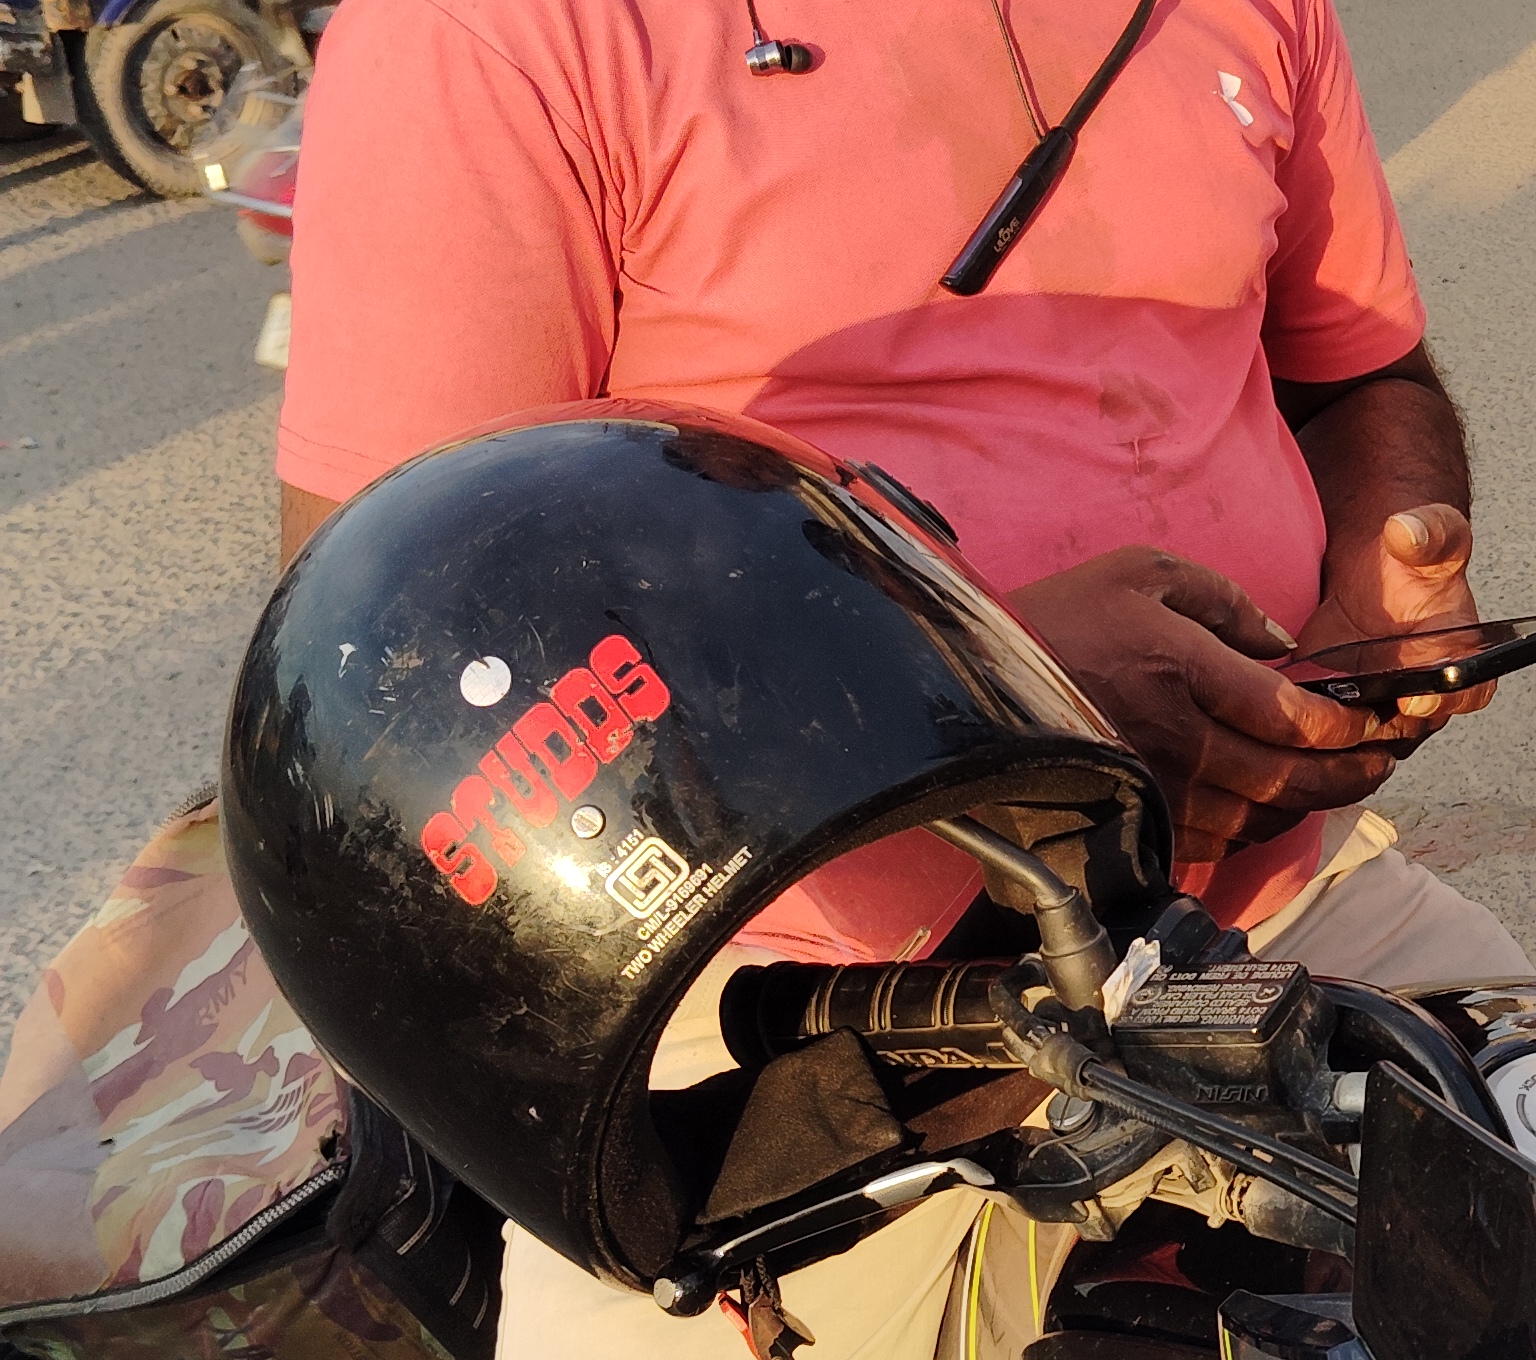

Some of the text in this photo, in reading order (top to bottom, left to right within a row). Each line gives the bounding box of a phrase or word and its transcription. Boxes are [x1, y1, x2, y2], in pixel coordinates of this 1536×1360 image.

[421, 634, 671, 906] STUDDS
[616, 828, 645, 859] 4151
[620, 846, 753, 980] TWO WHEELER HELMET
